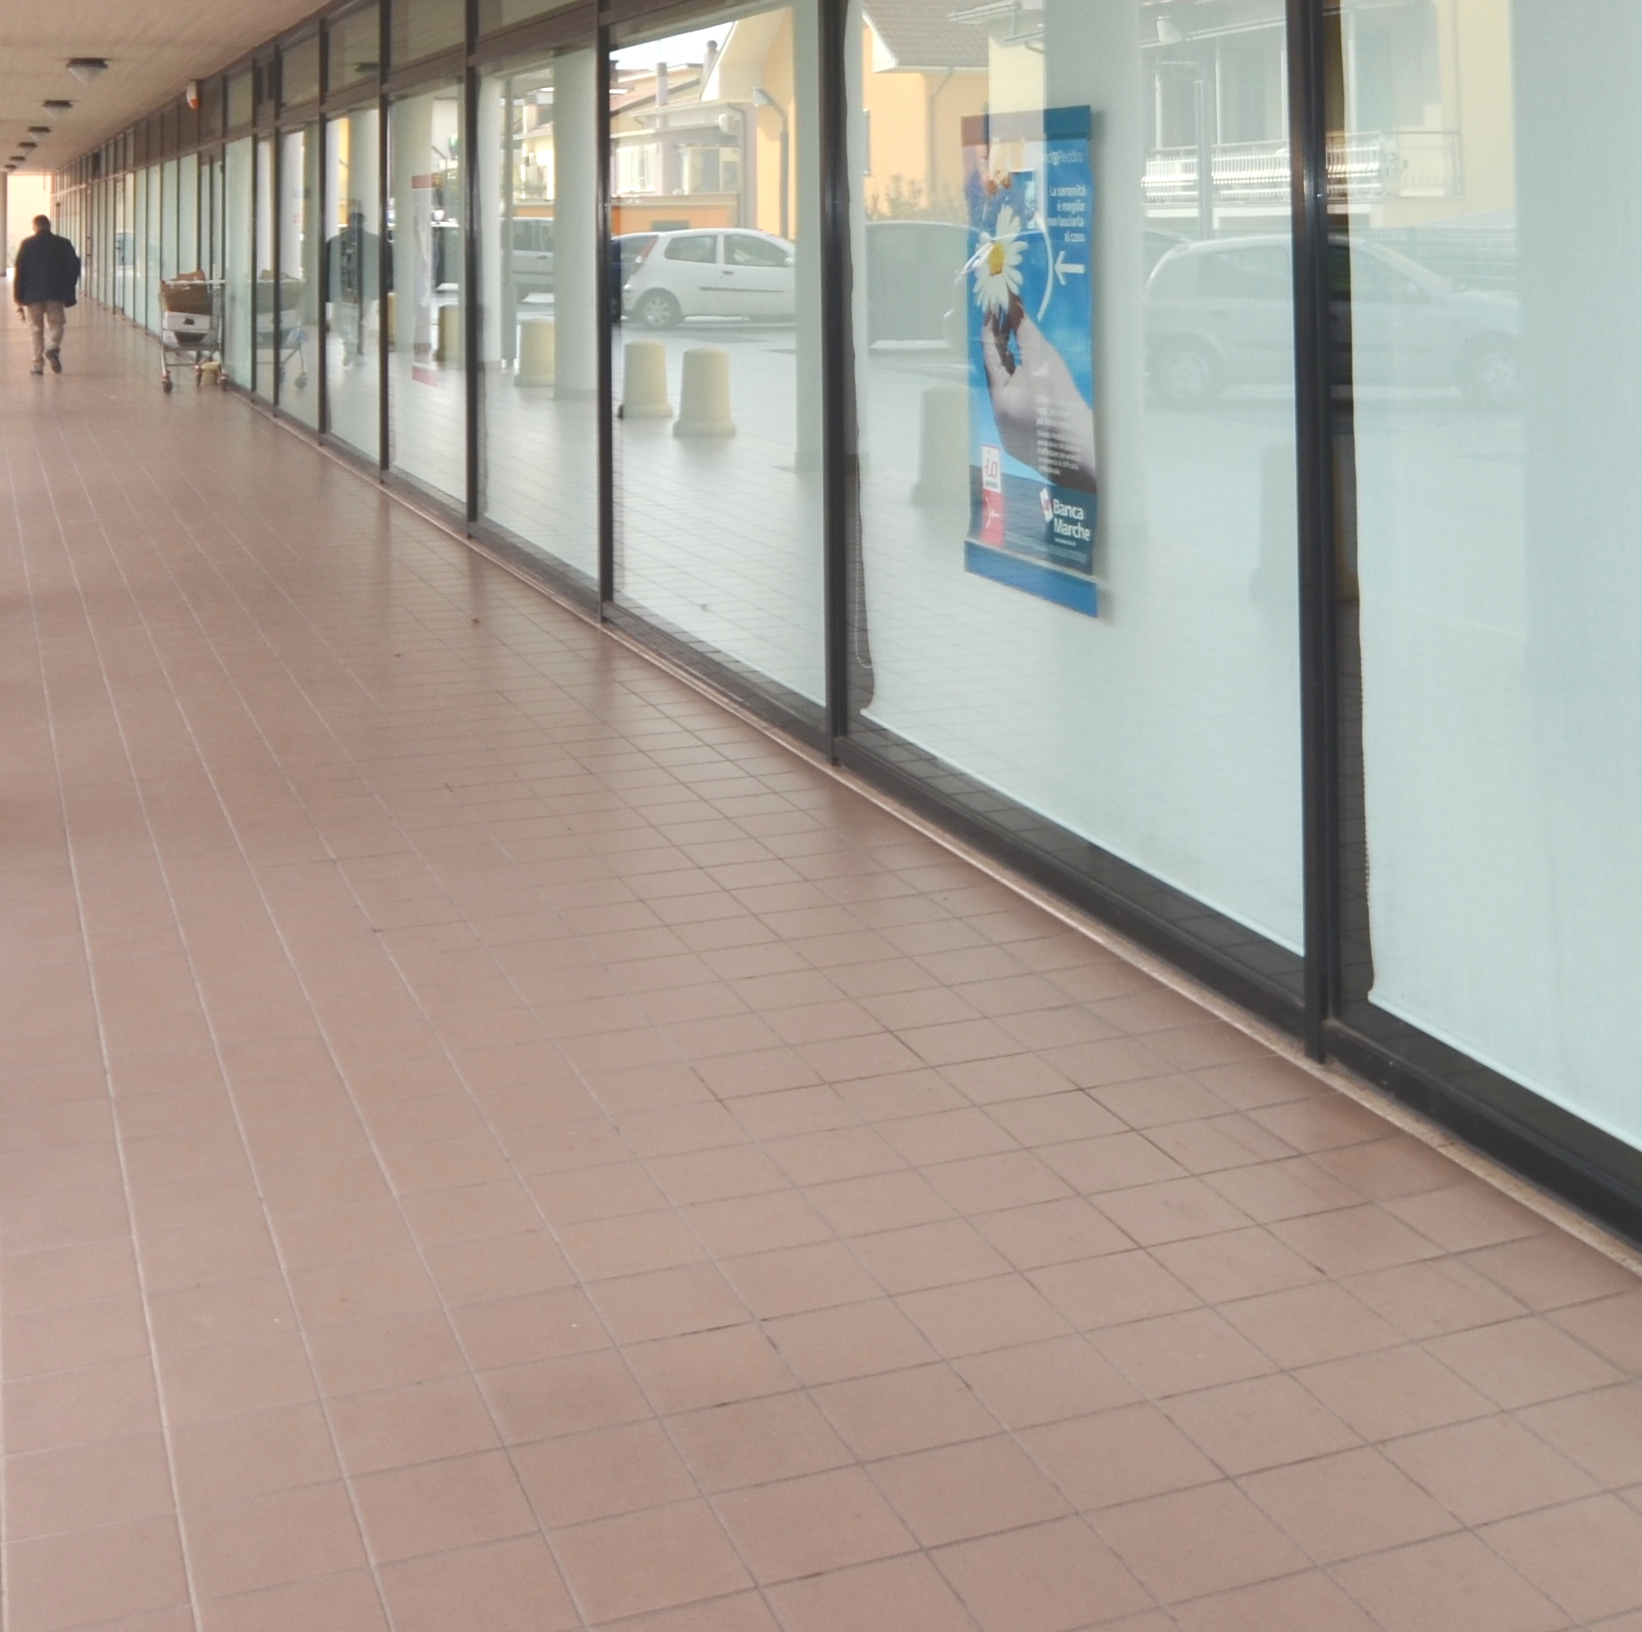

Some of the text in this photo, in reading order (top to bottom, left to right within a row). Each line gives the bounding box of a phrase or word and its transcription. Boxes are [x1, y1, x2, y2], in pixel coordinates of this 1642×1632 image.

[1062, 199, 1085, 215] meglio
[1053, 498, 1084, 520] Banca
[1053, 517, 1091, 541] Marche
